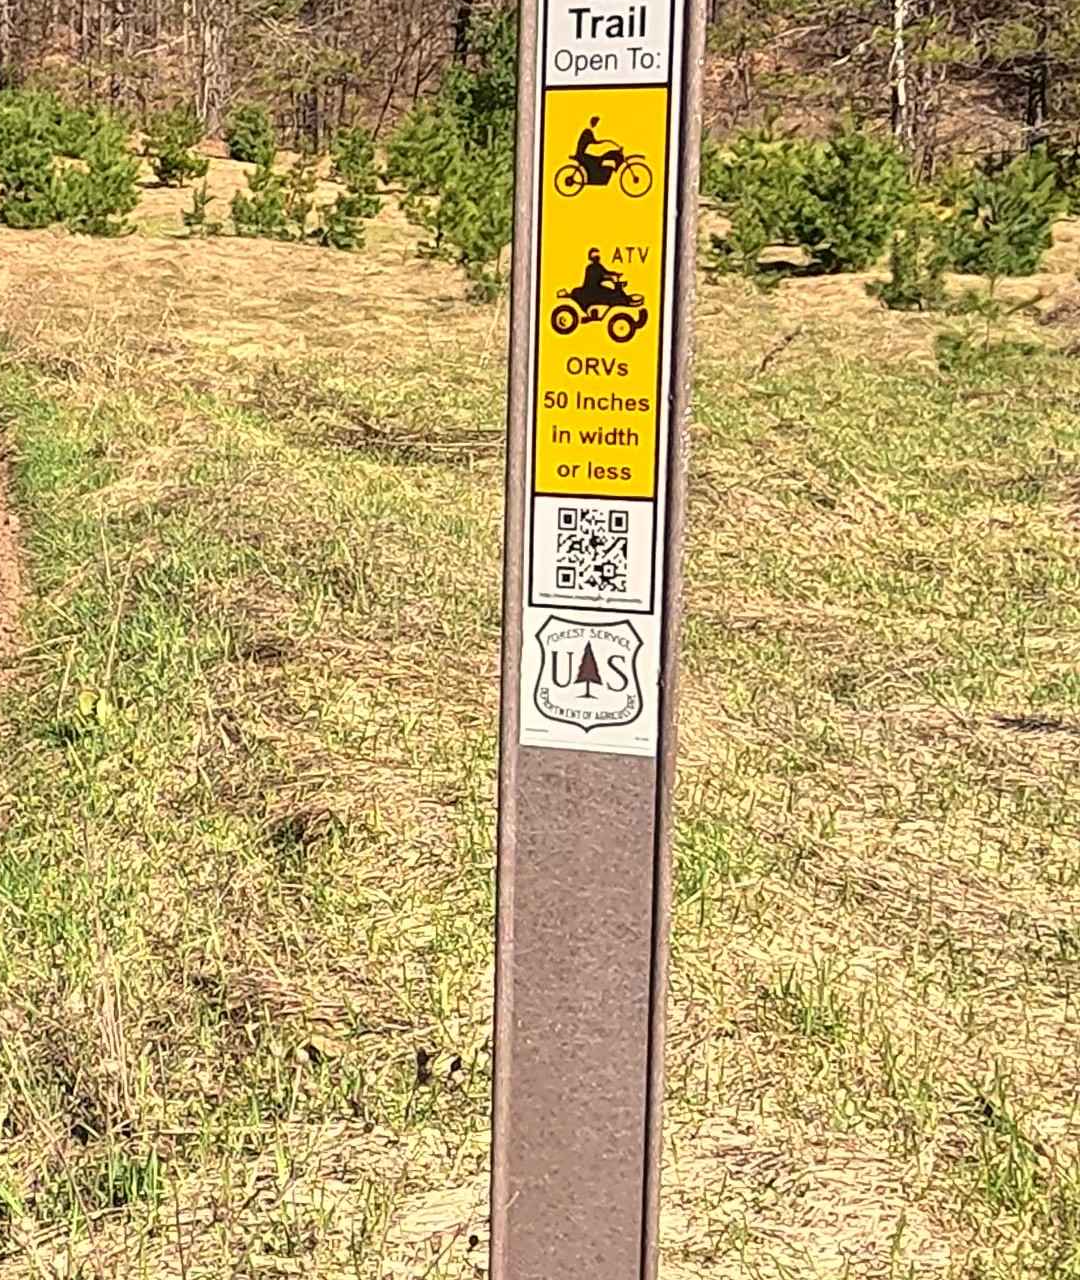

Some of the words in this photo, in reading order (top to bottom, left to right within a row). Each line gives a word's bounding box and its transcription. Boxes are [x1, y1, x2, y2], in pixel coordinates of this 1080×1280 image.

[568, 5, 647, 40] Trail
[554, 49, 618, 77] Open
[626, 47, 661, 70] To:
[611, 246, 649, 264] ATV
[566, 356, 629, 377] ORVs
[543, 390, 569, 410] 50
[576, 391, 650, 412] Inches
[552, 424, 571, 444] in
[579, 426, 639, 446] width
[557, 463, 580, 478] or
[588, 461, 632, 480] less
[547, 628, 584, 646] FOREST
